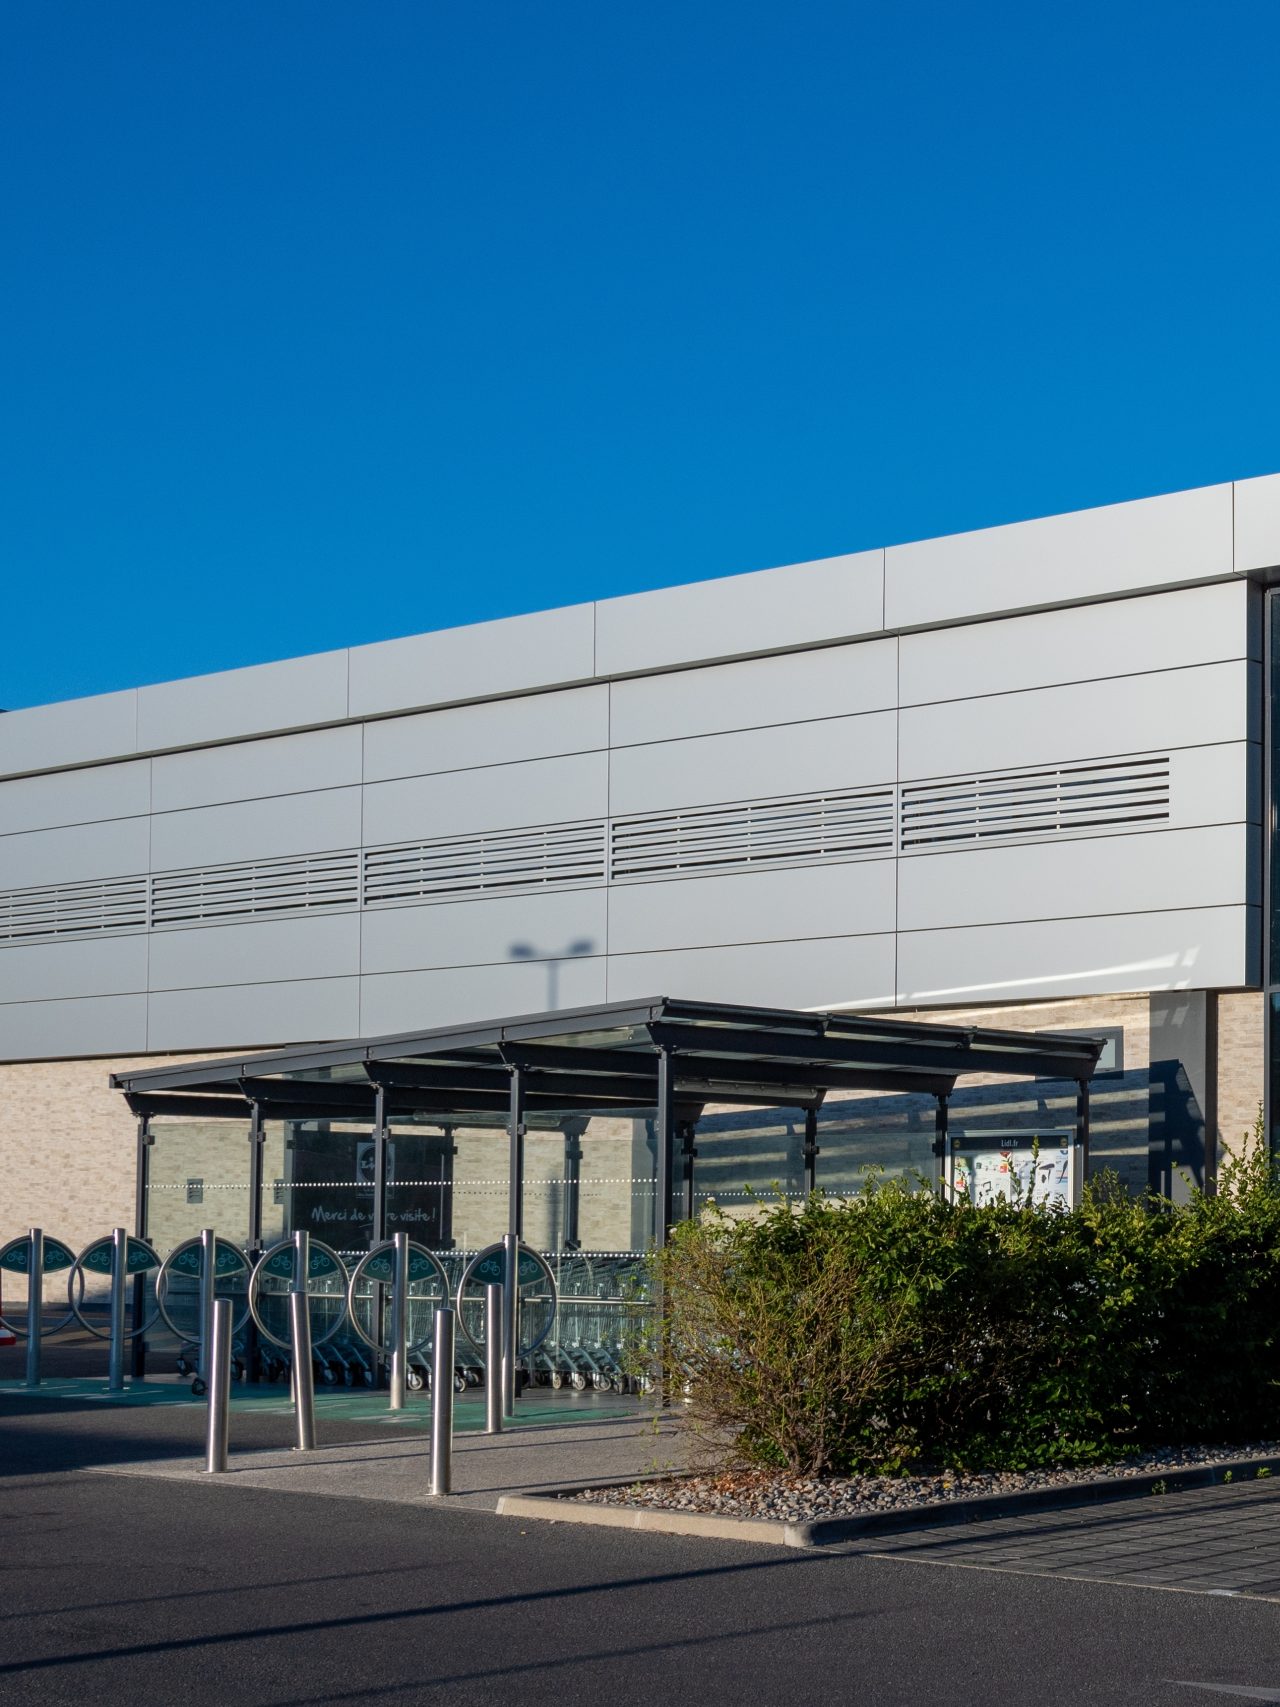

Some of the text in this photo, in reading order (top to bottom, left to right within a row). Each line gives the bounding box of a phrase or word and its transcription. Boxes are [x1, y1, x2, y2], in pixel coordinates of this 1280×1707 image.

[1001, 1139, 1018, 1147] Lidl.fr
[311, 1205, 347, 1222] Merci
[350, 1208, 366, 1221] de
[367, 1210, 398, 1221] vre
